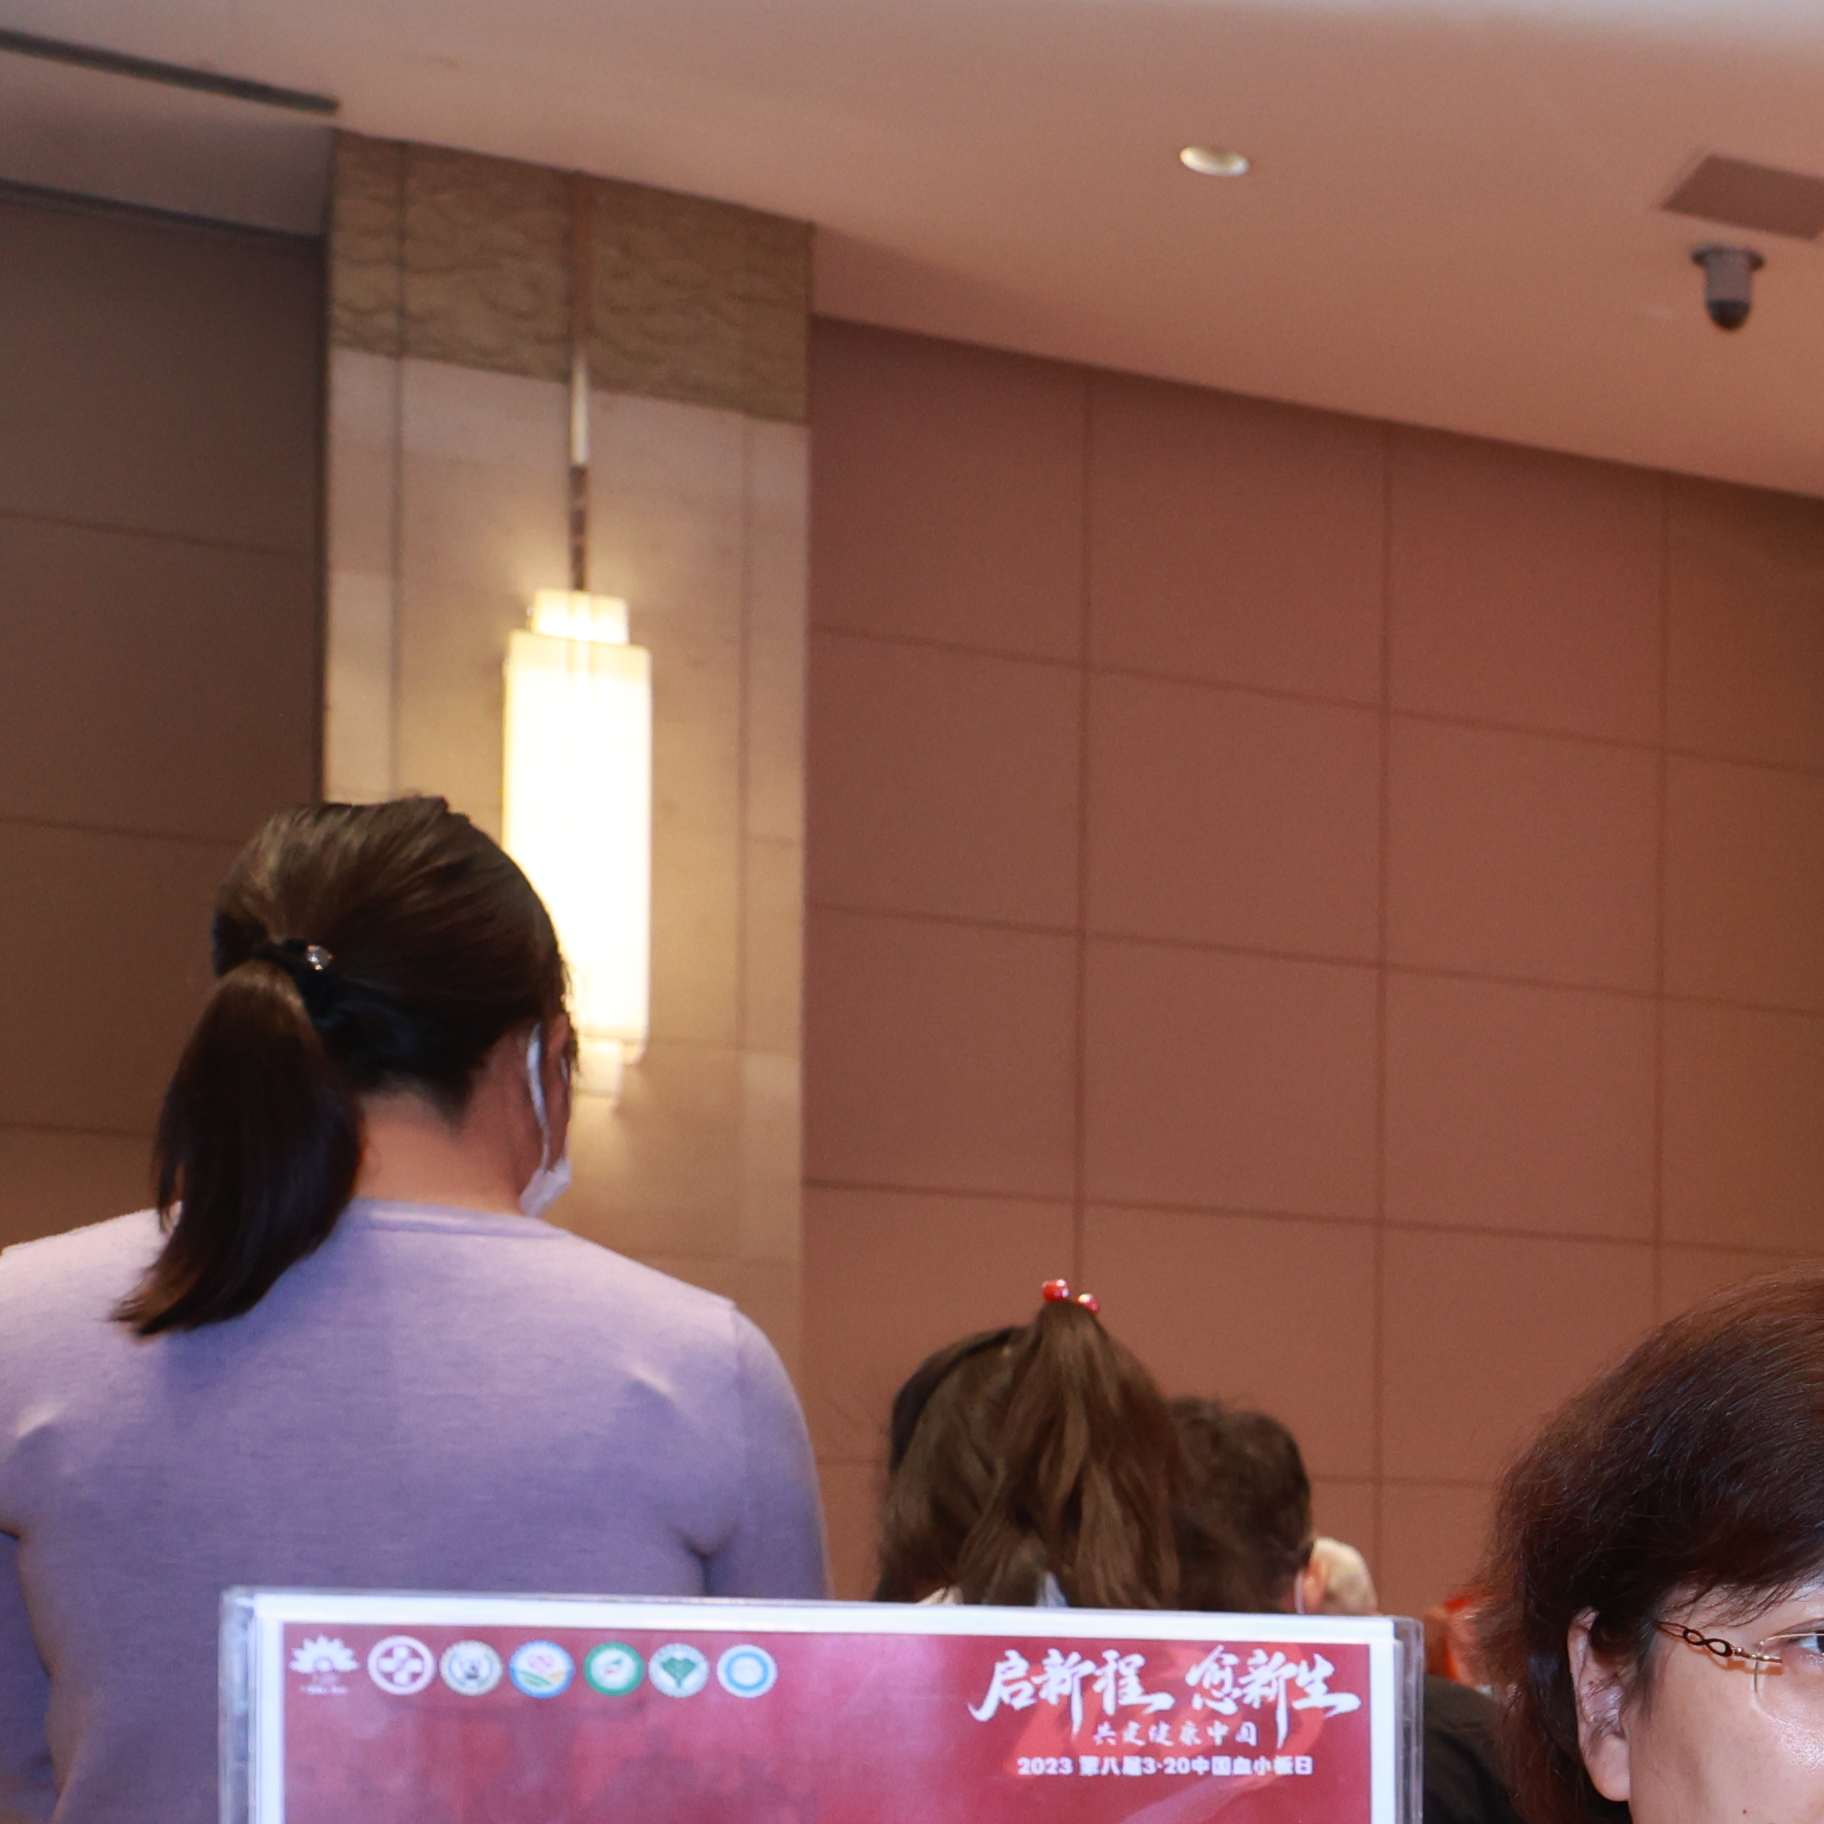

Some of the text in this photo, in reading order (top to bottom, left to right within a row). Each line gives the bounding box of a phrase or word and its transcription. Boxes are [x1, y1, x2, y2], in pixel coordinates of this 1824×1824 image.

[968, 1649, 1175, 1740] 启新程
[1017, 1756, 1074, 1776] 2023
